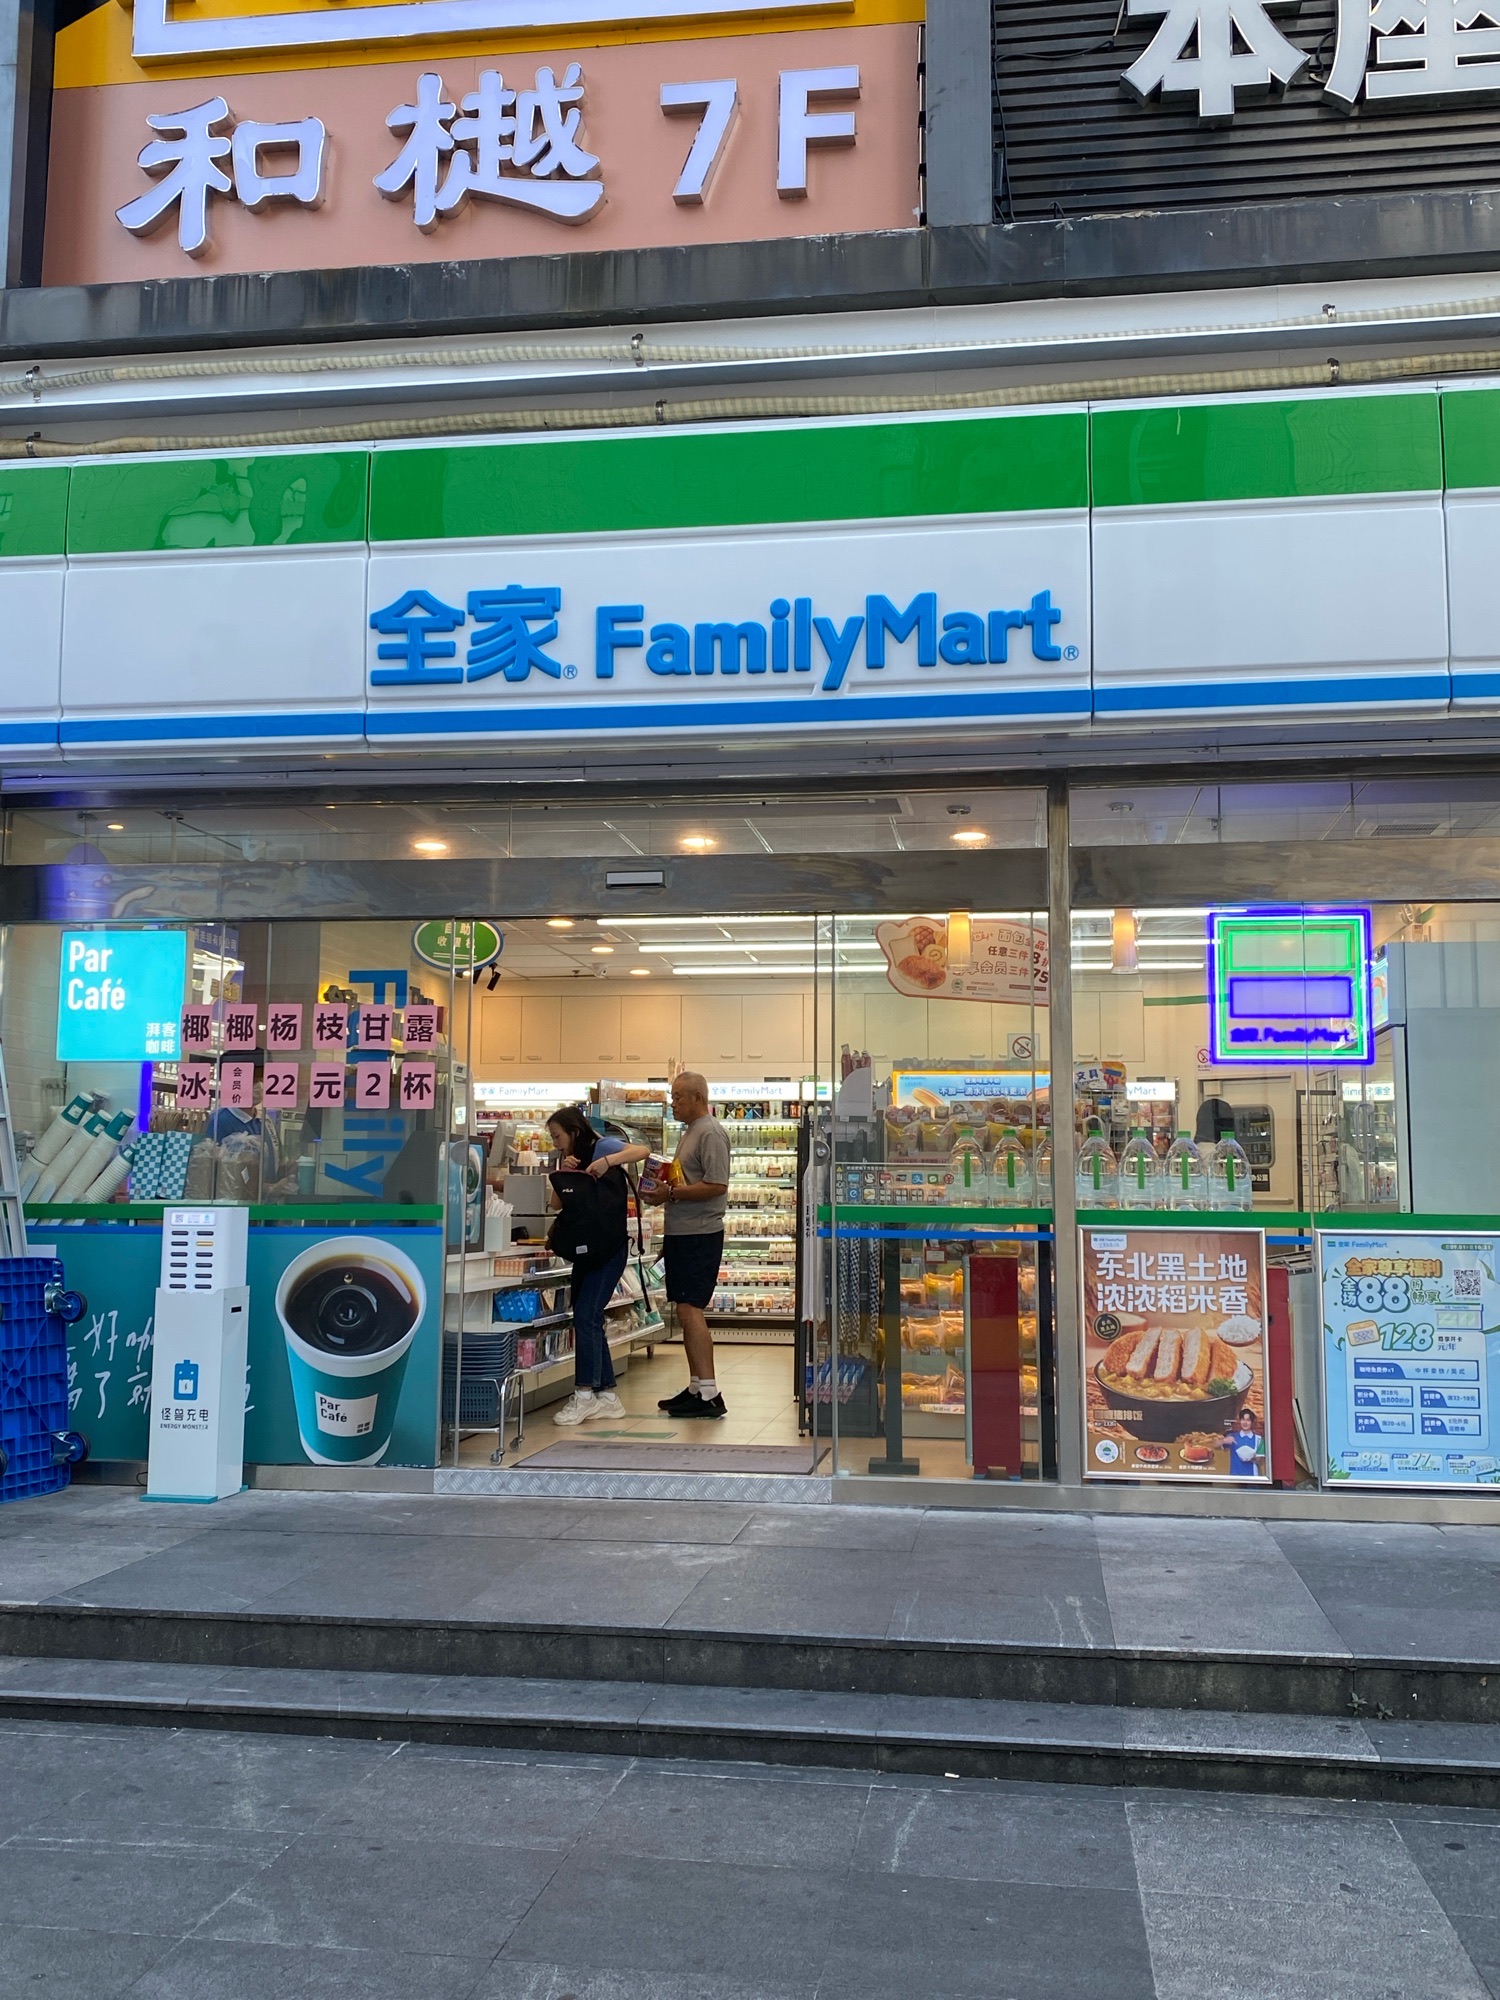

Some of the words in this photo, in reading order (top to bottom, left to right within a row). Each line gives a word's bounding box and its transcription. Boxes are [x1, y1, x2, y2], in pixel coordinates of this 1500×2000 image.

[370, 584, 562, 686] 全家
[595, 589, 1062, 691] FamilyMart
[69, 941, 113, 973] Par
[67, 978, 126, 1011] Café
[145, 1022, 176, 1038] 湃客
[182, 1012, 434, 1043] 椰椰杨枝甘露
[145, 1039, 176, 1054] 咖啡
[179, 1071, 207, 1100] 冰
[231, 1066, 243, 1104] 会员价
[1076, 1068, 1099, 1081] 文具
[499, 1086, 549, 1097] FamilyMart
[731, 1086, 782, 1096] FamilyMart
[1352, 1241, 1388, 1249] FamilyMart
[1096, 1251, 1248, 1283] 东北黑土地
[1345, 1257, 1442, 1279] 全家尊享福利
[1097, 1283, 1248, 1314] 浓浓稻米香
[1357, 1277, 1410, 1313] 88
[1380, 1322, 1435, 1351] 128
[161, 1407, 209, 1421] 怪兽充电
[320, 1396, 341, 1411] Par
[320, 1408, 348, 1423] Café
